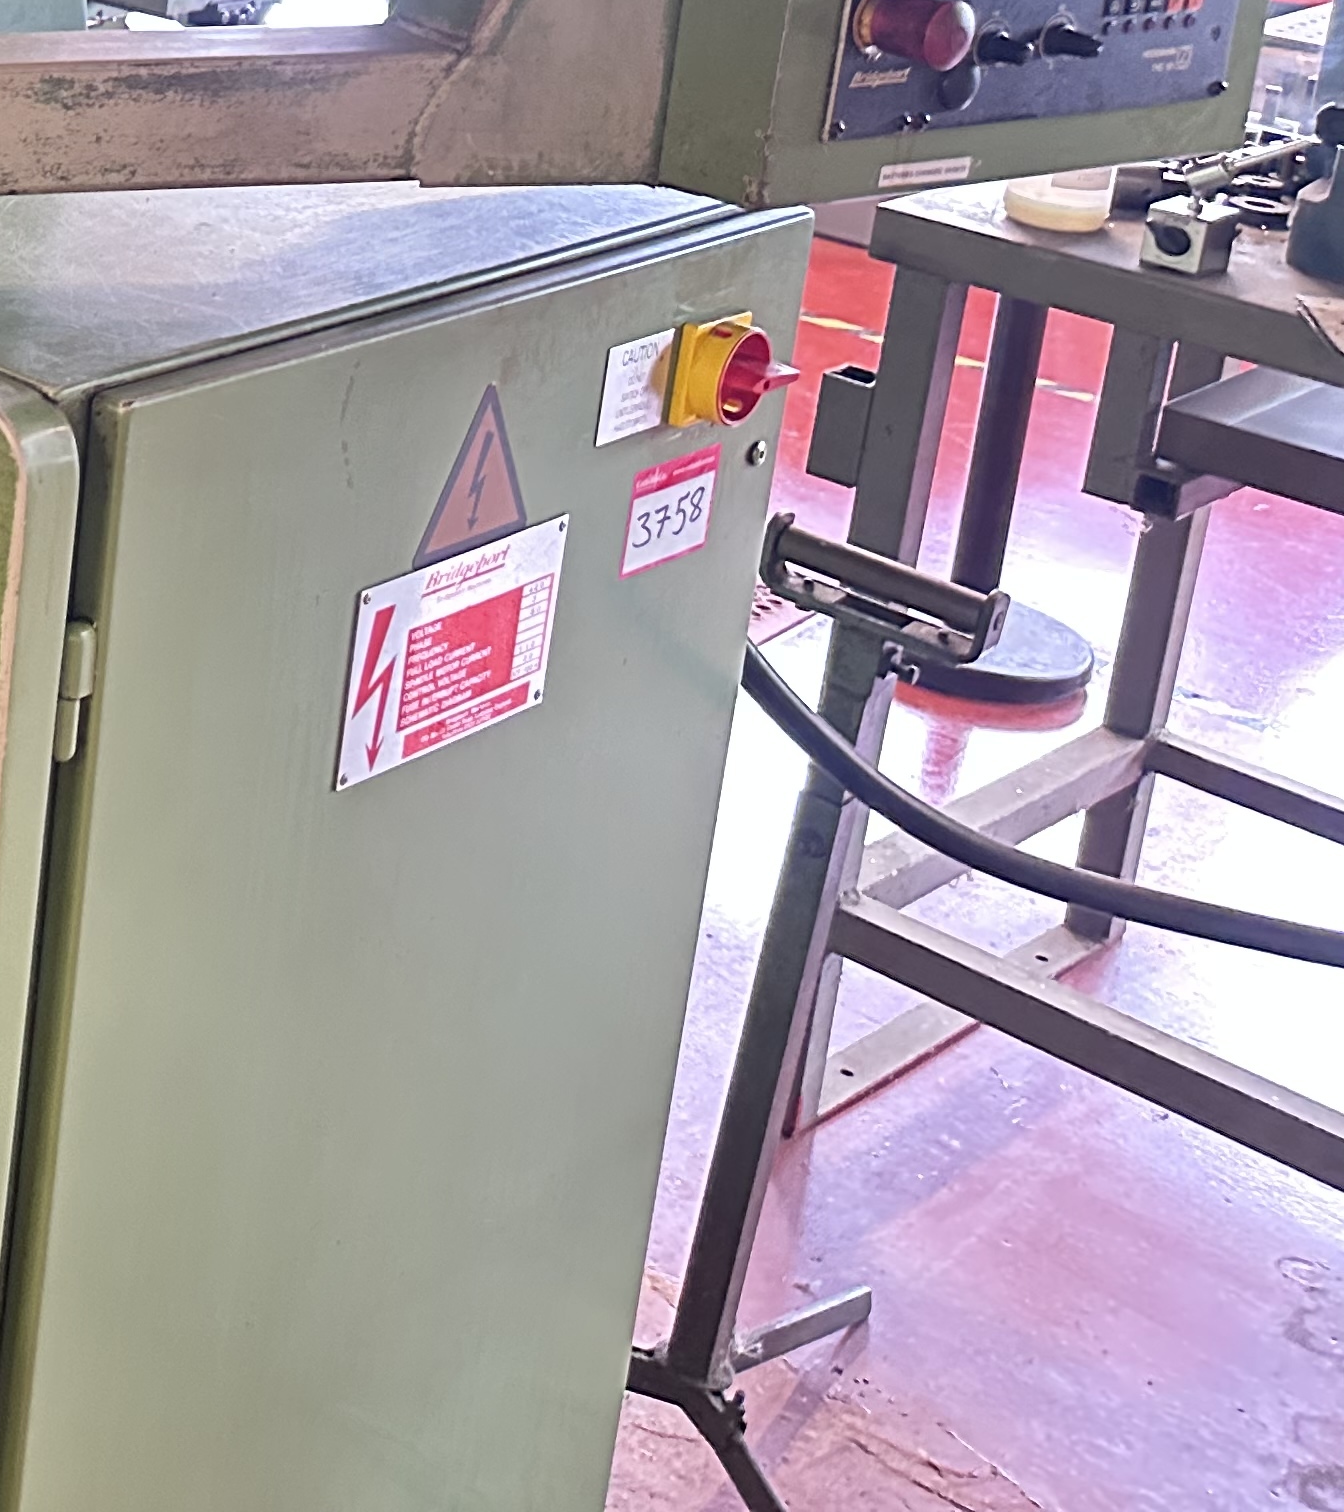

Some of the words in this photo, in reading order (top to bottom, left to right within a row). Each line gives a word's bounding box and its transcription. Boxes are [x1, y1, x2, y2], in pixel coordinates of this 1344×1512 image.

[623, 341, 660, 367] CAUTION
[632, 486, 705, 548] 3758
[426, 544, 511, 591] Bridgeport
[444, 641, 476, 662] CURRENT
[461, 646, 491, 666] CURRENT
